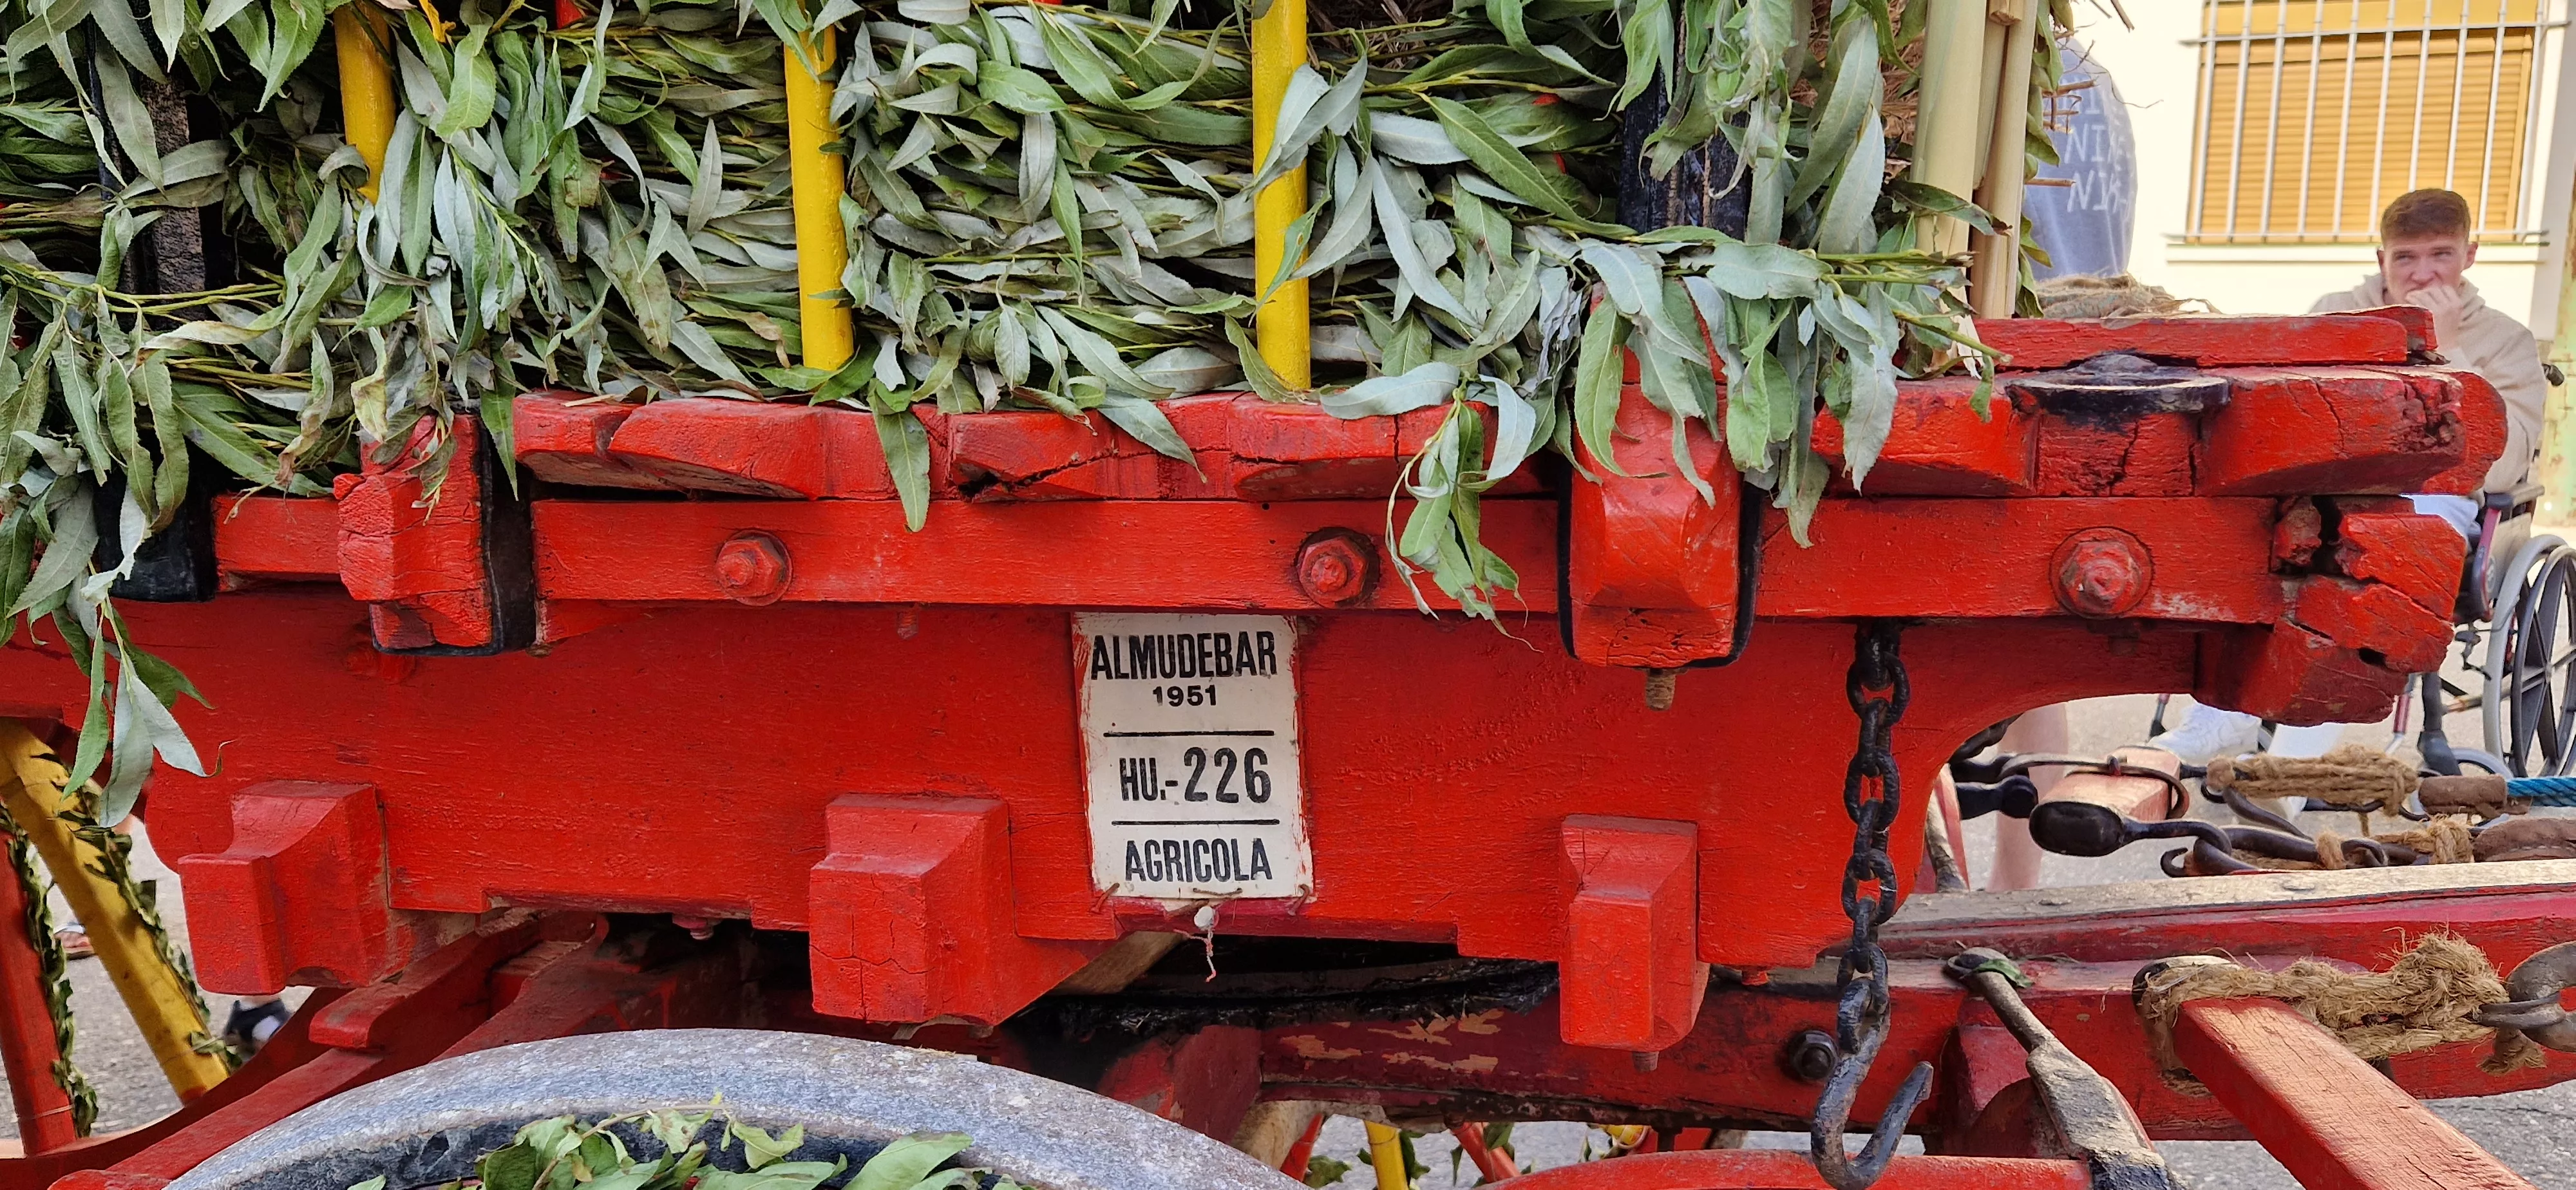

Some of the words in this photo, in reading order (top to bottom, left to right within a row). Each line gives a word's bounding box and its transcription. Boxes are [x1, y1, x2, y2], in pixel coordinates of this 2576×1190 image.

[1090, 630, 1278, 680] ALMUDEBAR
[1152, 685, 1217, 707] 1951
[1124, 837, 1273, 882] AGRICOLA
